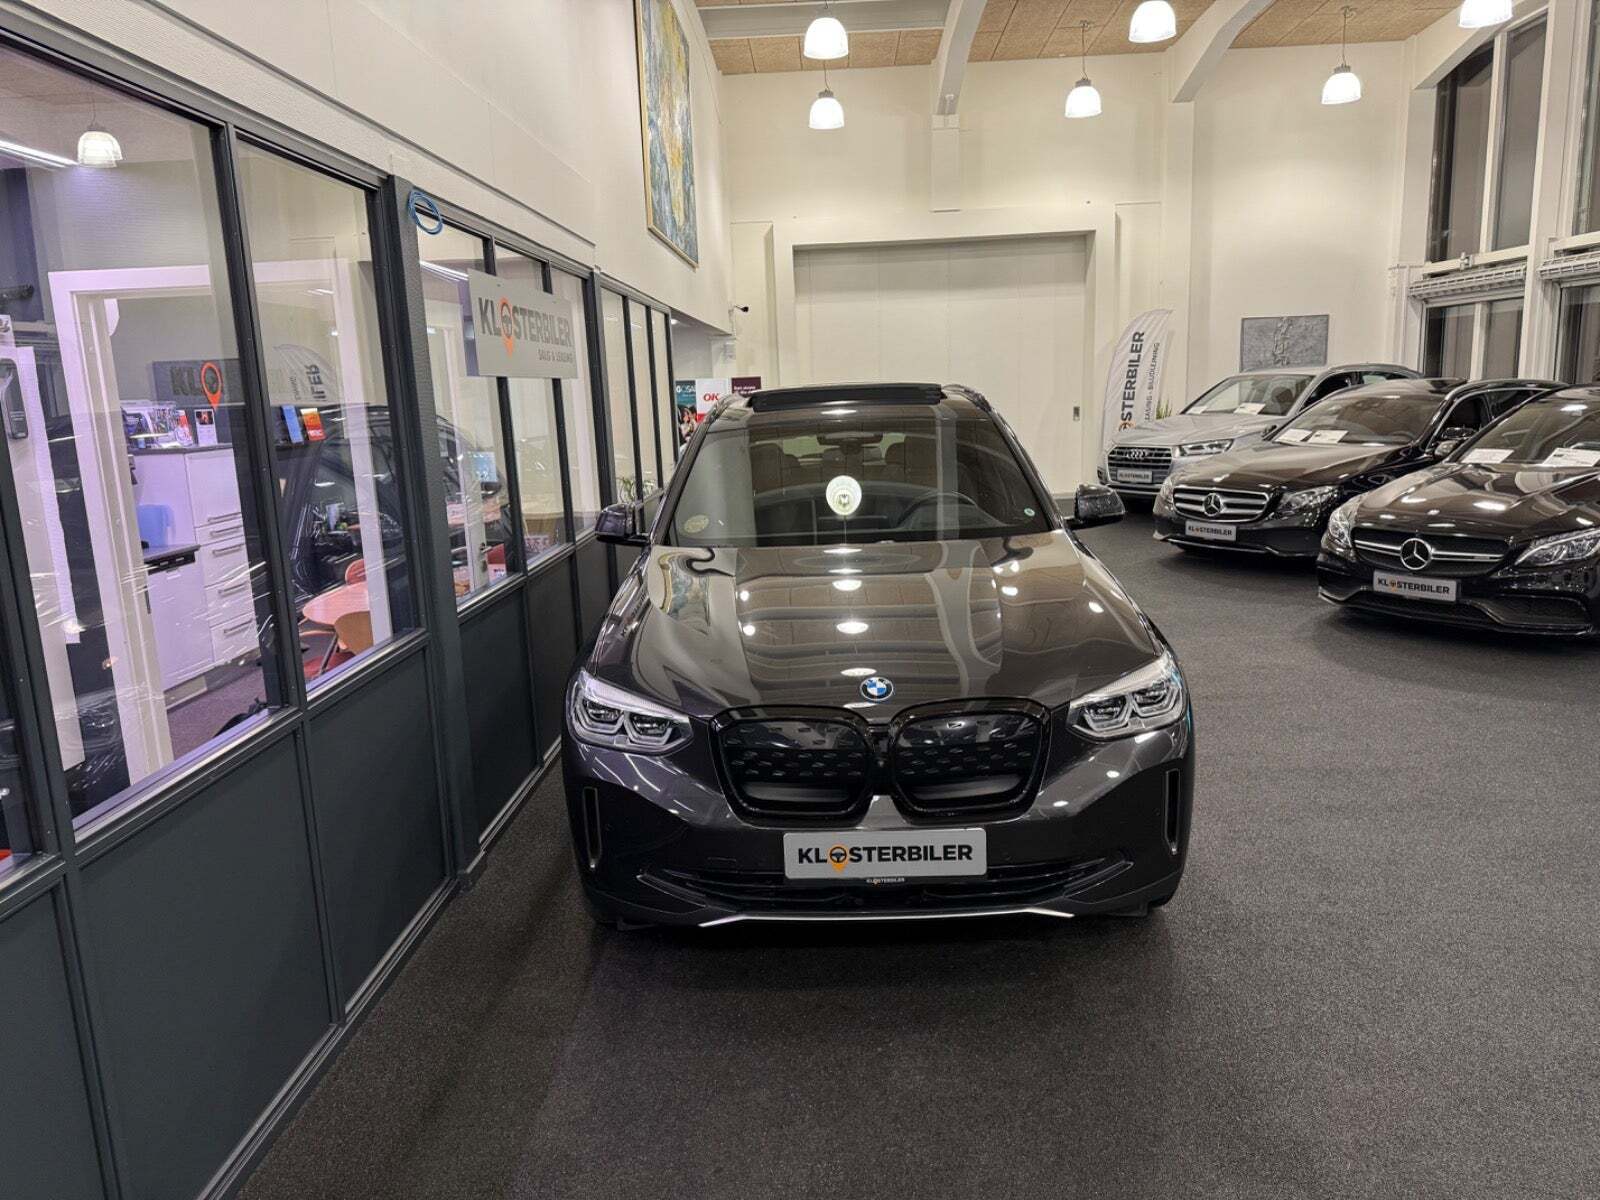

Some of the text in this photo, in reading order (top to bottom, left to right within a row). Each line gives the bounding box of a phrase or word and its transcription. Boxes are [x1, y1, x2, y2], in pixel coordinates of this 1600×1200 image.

[478, 297, 572, 347] KLOSTERBILER
[703, 393, 719, 402] OK
[1377, 577, 1450, 594] KLOSTERBILER
[798, 843, 973, 865] KLOSTERBILER
